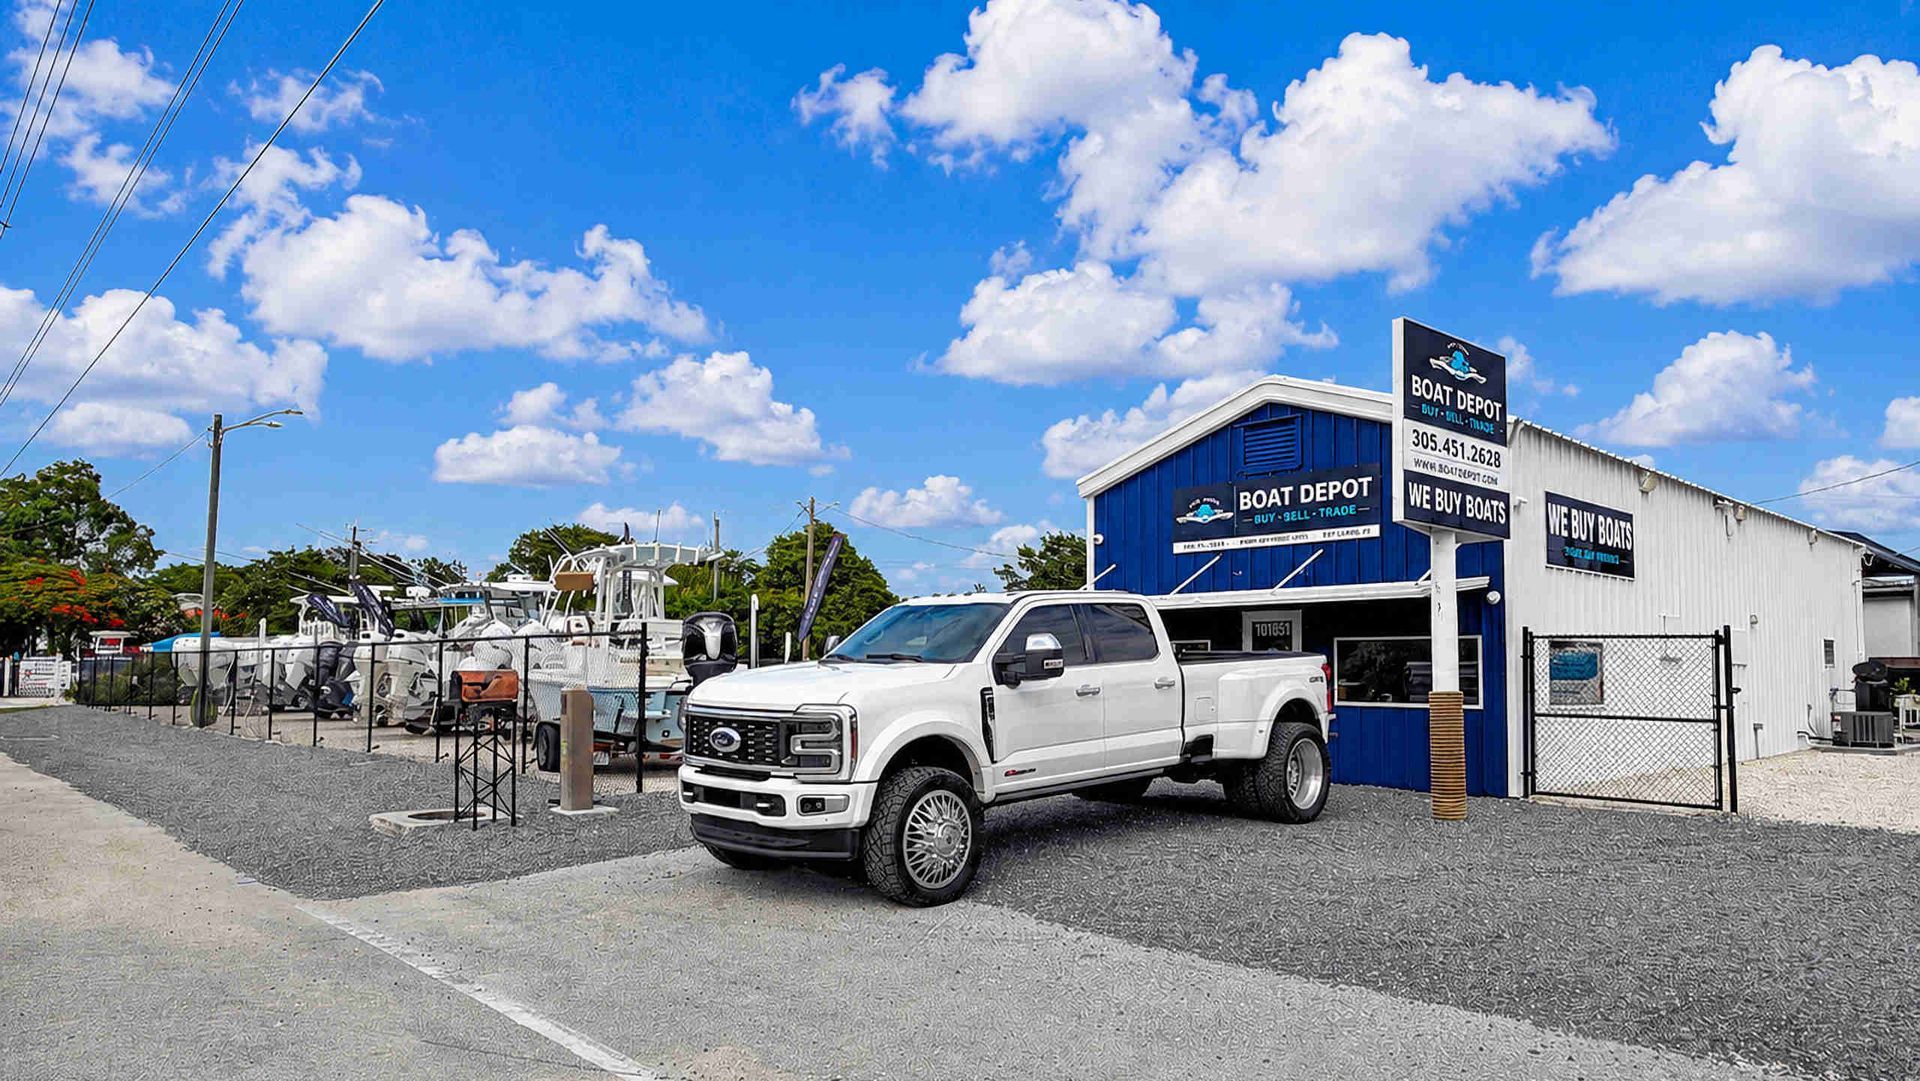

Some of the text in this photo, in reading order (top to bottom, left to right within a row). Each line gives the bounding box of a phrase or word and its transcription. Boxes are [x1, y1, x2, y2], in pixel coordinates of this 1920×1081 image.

[1411, 374, 1502, 422] BOAT DEPOT
[1421, 403, 1439, 418] BUY
[1412, 429, 1501, 468] 305.451.2628
[1239, 486, 1293, 511] BOAT
[1300, 476, 1373, 504] DEPOT
[1408, 481, 1506, 525] WE BUY BOATS
[1254, 504, 1357, 525] BUY SELL TRADE
[1547, 502, 1632, 551] WE BUY BOATS
